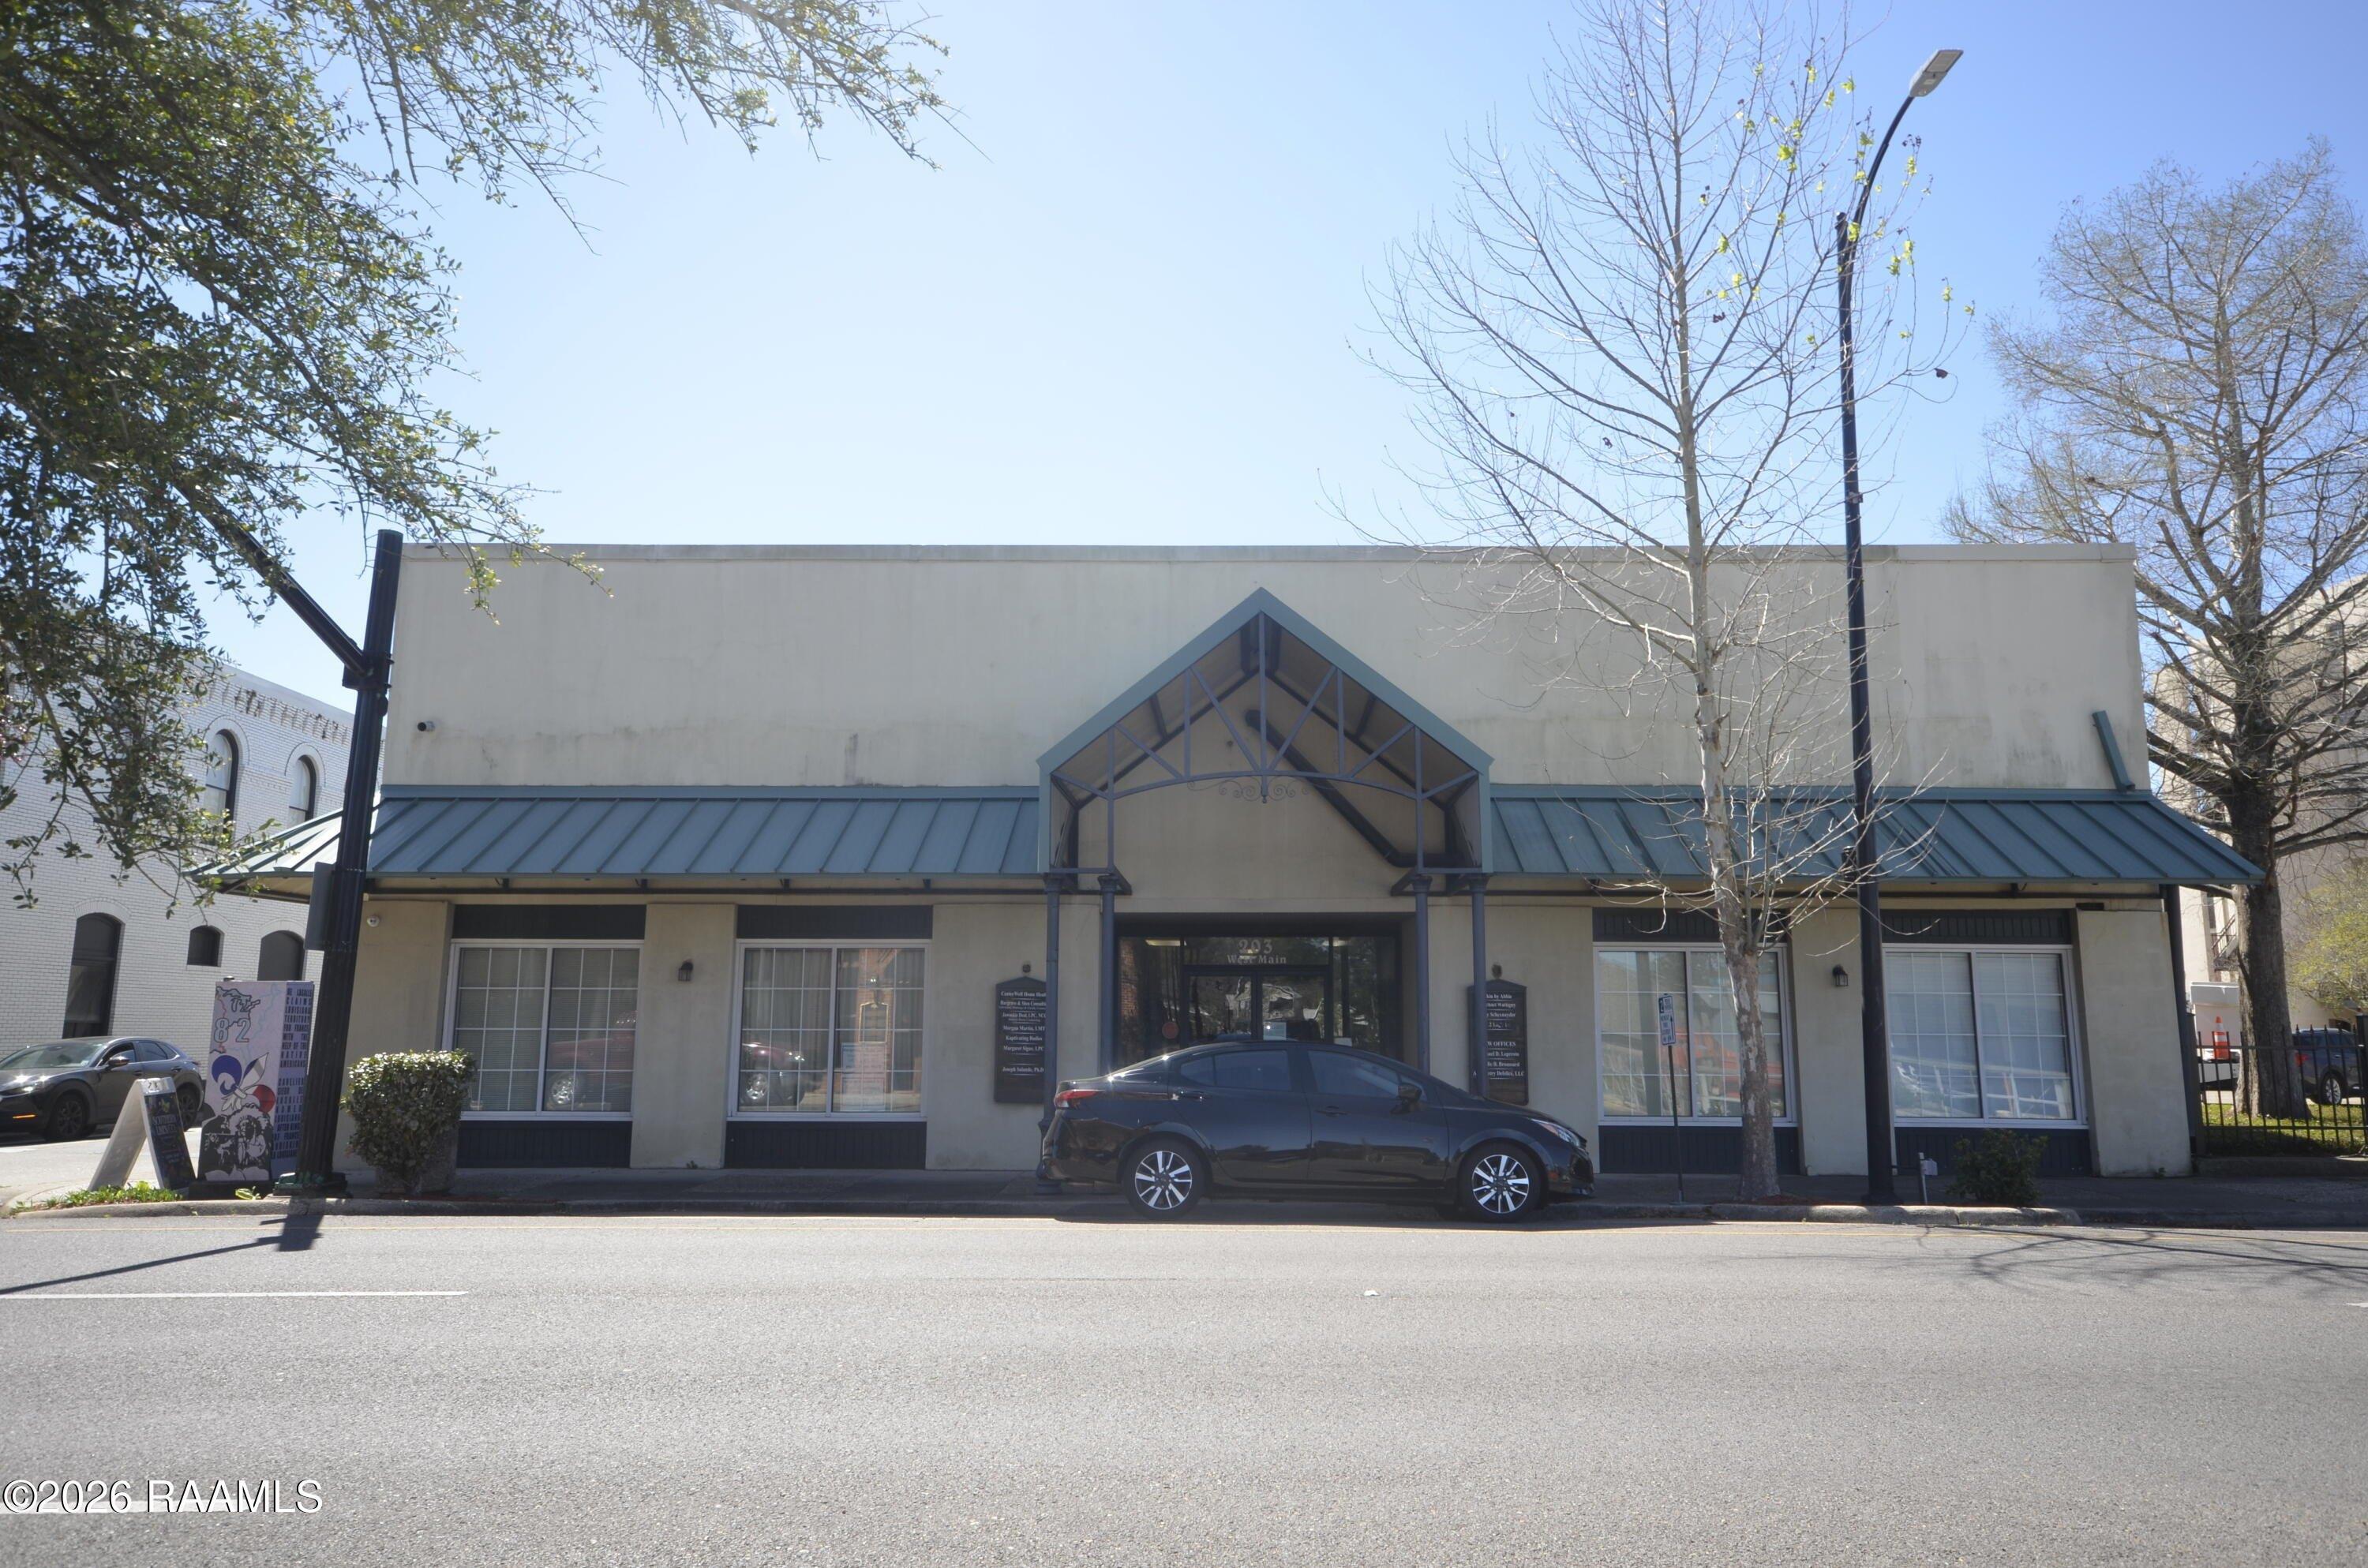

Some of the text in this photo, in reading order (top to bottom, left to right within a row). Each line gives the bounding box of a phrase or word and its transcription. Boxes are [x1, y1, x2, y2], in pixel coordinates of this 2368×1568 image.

[1238, 939, 1272, 954] 203
[1227, 955, 1287, 964] West Main
[284, 1015, 310, 1024] TERRITORY
